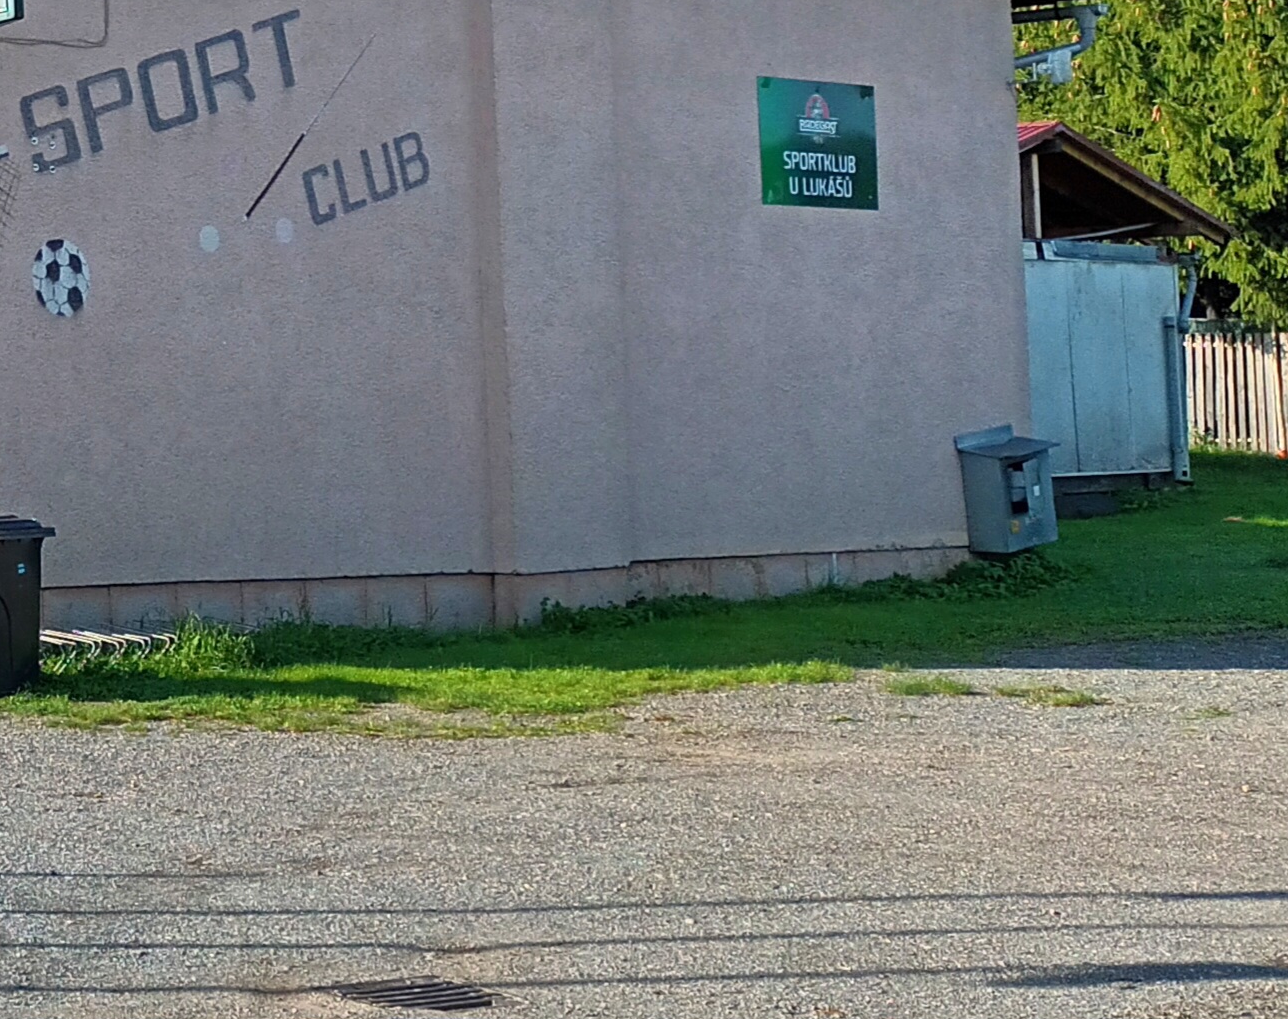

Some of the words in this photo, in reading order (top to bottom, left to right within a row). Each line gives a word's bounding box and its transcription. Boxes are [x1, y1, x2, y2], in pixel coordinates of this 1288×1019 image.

[20, 9, 300, 173] SPORT
[302, 131, 430, 225] CLUB
[783, 151, 857, 174] SPORTKLUB
[789, 176, 799, 195] U
[802, 175, 853, 198] LUKÁŠŮ
